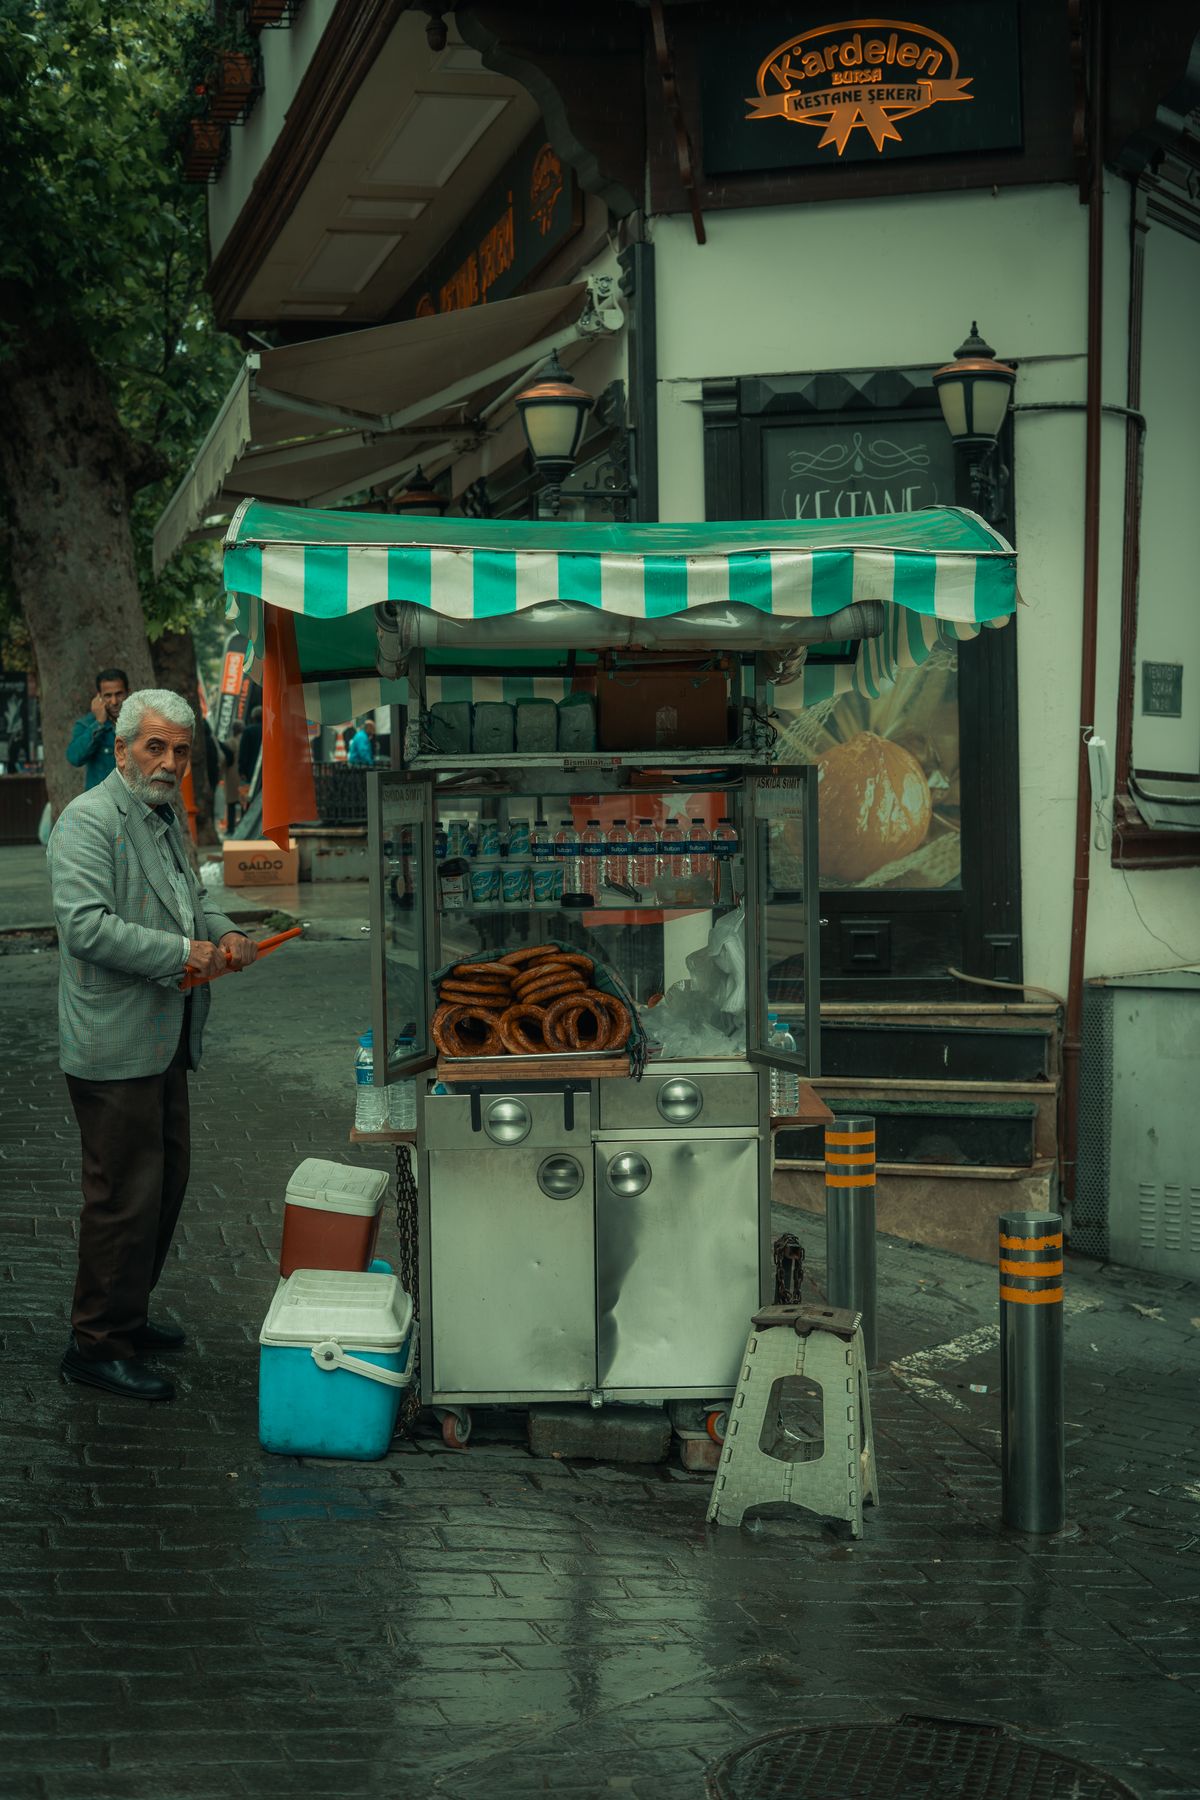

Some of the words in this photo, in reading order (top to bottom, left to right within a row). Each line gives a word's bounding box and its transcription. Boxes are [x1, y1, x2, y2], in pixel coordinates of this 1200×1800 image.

[770, 33, 943, 90] Kardelen
[831, 68, 883, 85] BURSA
[793, 90, 862, 111] KESTANE
[867, 86, 922, 104] ŞEKERİ
[225, 655, 241, 692] KURS
